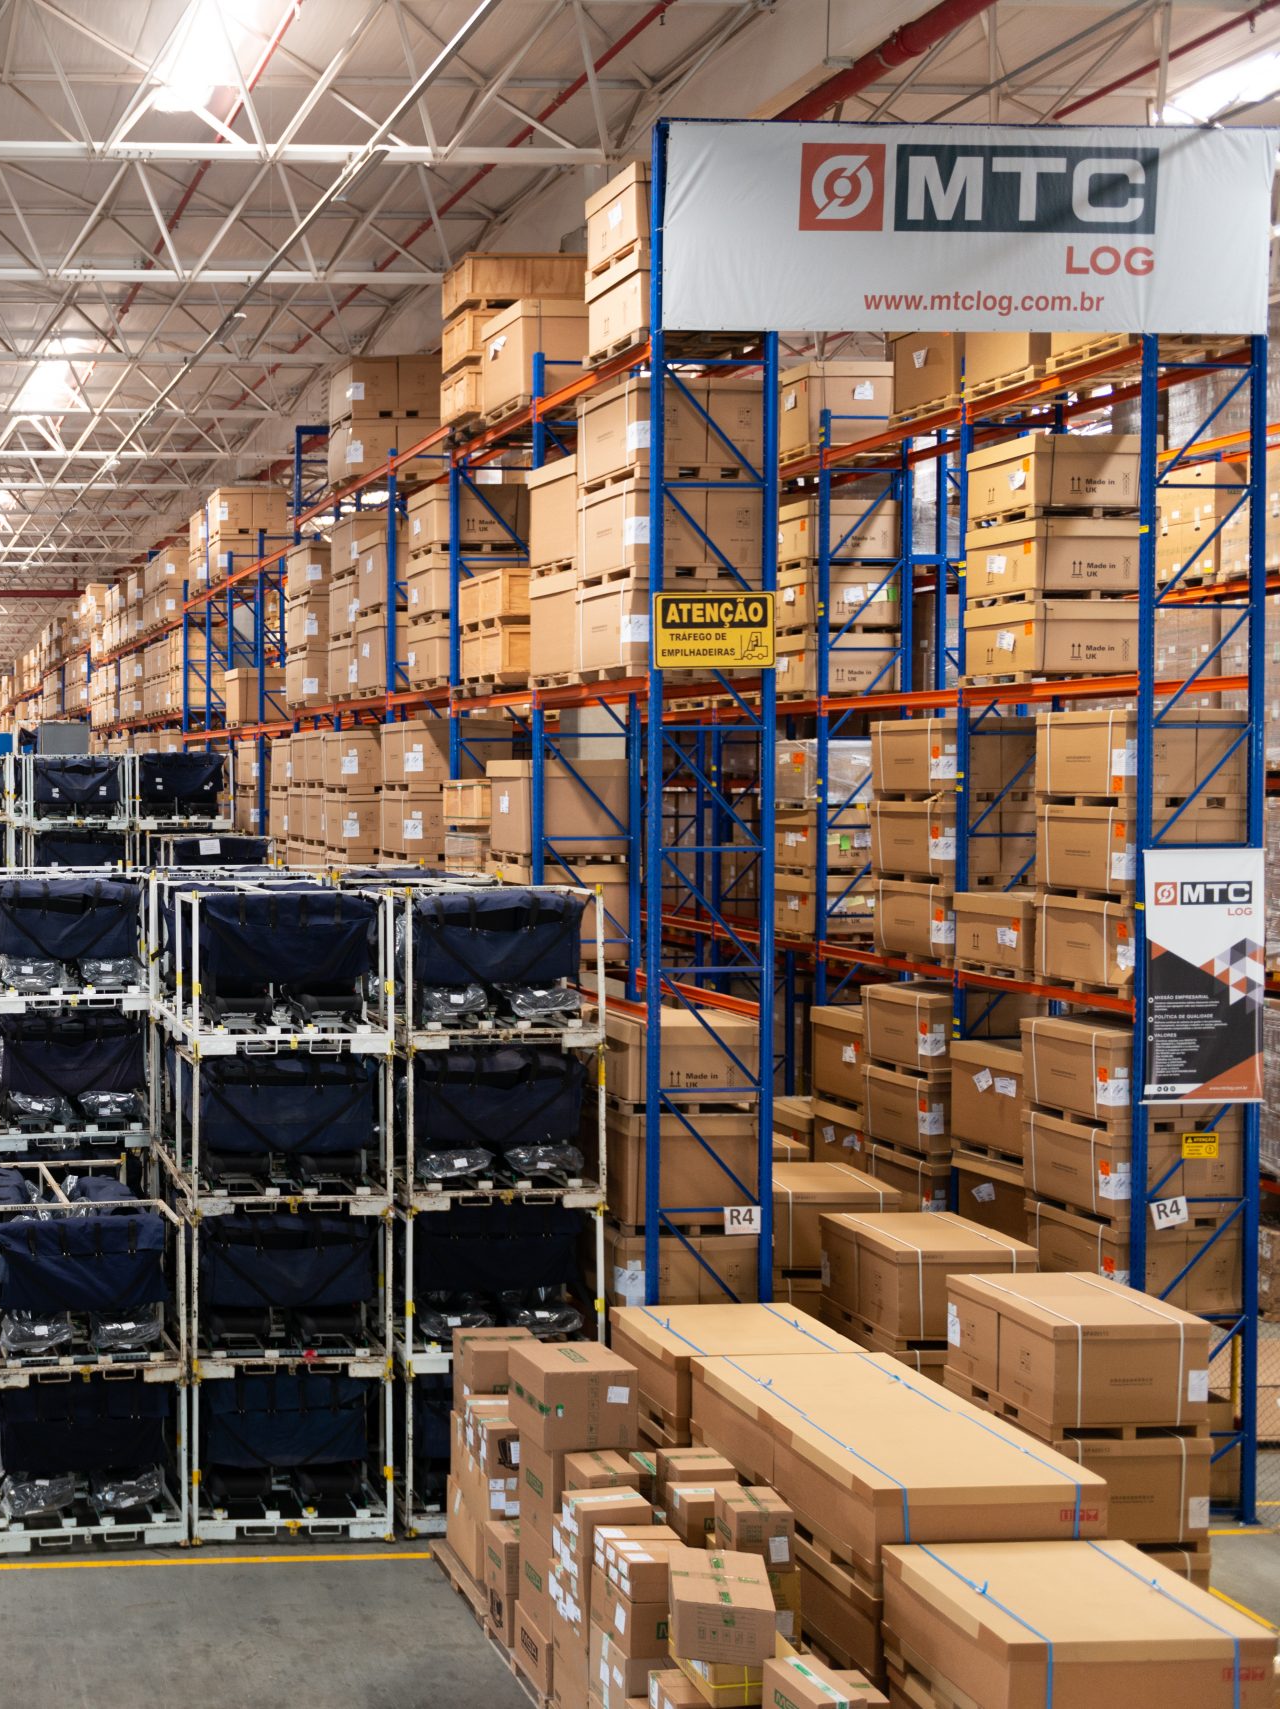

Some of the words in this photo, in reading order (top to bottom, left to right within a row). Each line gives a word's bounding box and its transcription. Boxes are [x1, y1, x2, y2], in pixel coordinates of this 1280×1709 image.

[906, 155, 1146, 223] MTC
[1065, 245, 1155, 276] LOG
[863, 290, 1105, 316] www.mtclog.com.br
[1085, 478, 1106, 486] Made
[1107, 478, 1115, 486] in
[1085, 486, 1097, 494] UK
[1086, 562, 1107, 570] Made
[665, 597, 764, 628] ATENÇÃO
[669, 631, 712, 641] TRÁFEGO
[714, 632, 727, 640] DE
[661, 647, 736, 657] EMPILHADEIRAS
[1085, 644, 1105, 652] Made
[1182, 883, 1250, 903] MTC
[1227, 907, 1253, 916] LOG
[729, 1207, 754, 1226] R4
[1156, 1199, 1181, 1220] R4
